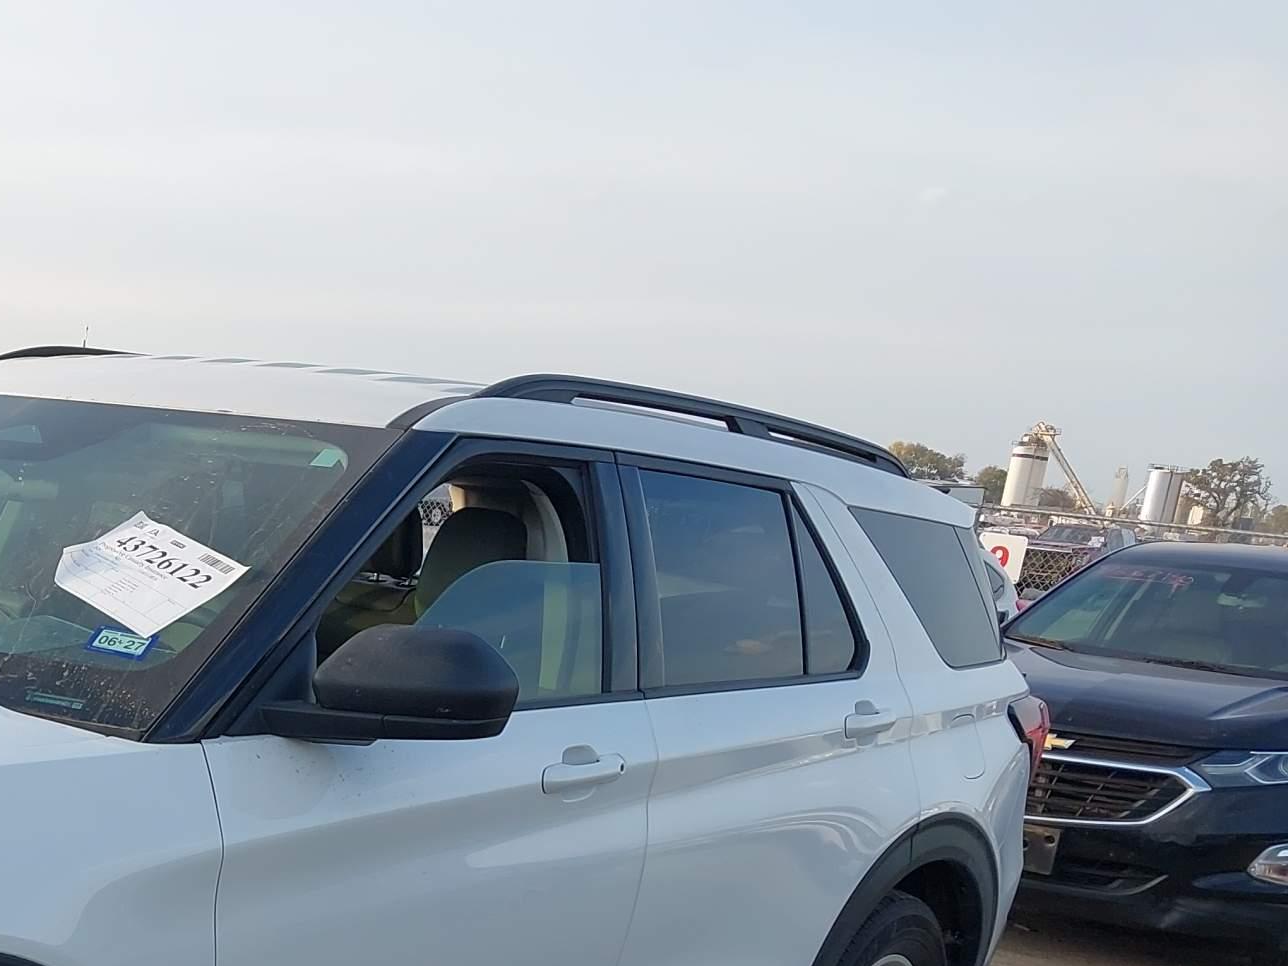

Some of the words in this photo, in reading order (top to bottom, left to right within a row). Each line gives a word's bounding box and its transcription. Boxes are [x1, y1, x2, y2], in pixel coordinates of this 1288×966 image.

[116, 536, 212, 589] 43726122
[98, 635, 119, 646] 06
[123, 640, 147, 650] 27
